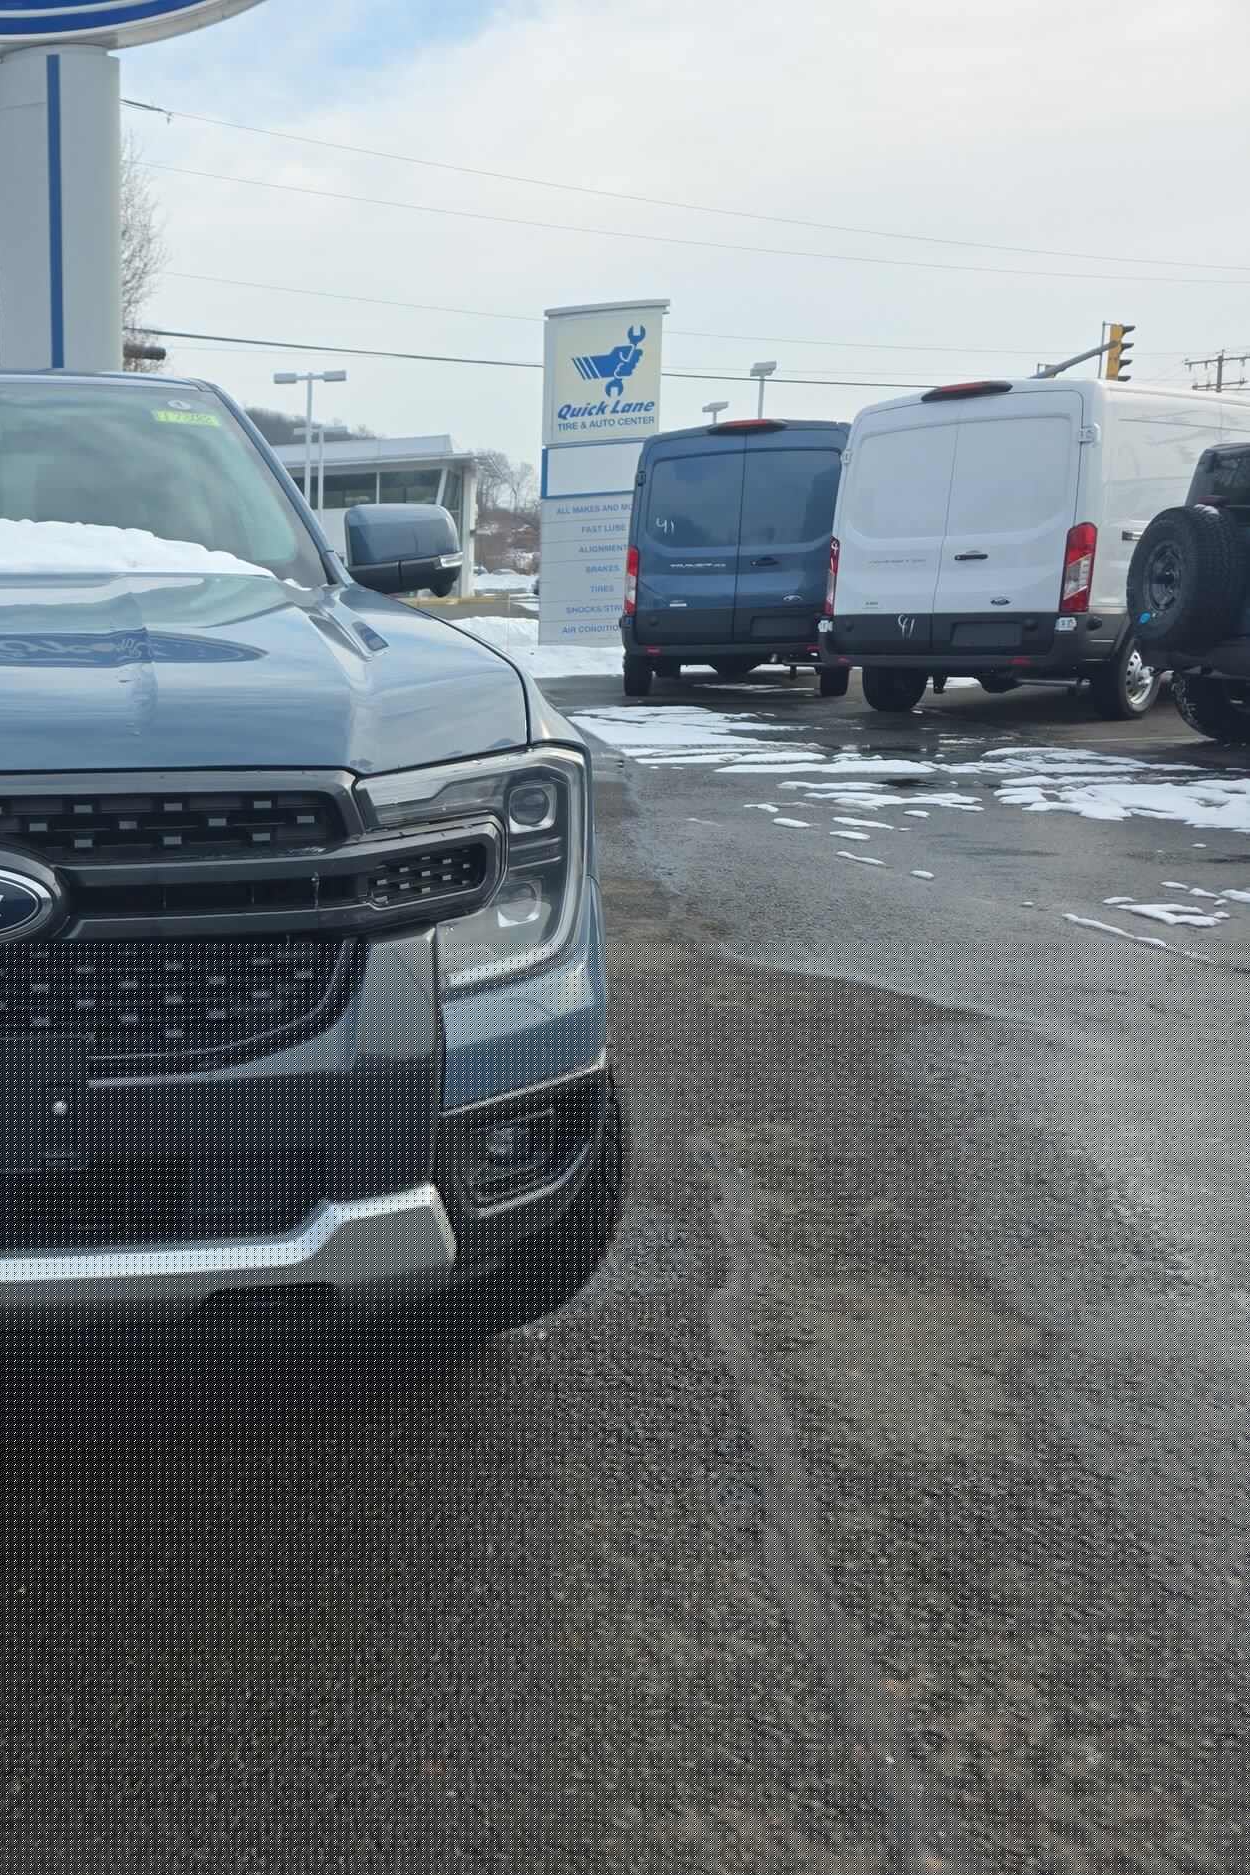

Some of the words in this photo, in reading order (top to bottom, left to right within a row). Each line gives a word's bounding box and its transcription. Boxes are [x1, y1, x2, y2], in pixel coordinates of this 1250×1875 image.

[558, 401, 608, 420] Quick
[610, 400, 655, 414] Lane
[558, 422, 580, 431] TIRE
[581, 422, 587, 430] &
[589, 419, 615, 428] AUTO
[617, 417, 655, 426] CENTER
[556, 506, 571, 515] ALL
[572, 504, 601, 513] MAKES
[602, 503, 620, 512] AND
[581, 525, 604, 534] FAST
[604, 523, 627, 532] LUBE
[585, 565, 621, 574] BRAKES
[590, 584, 615, 593] TIRES
[562, 625, 577, 634] AIR
